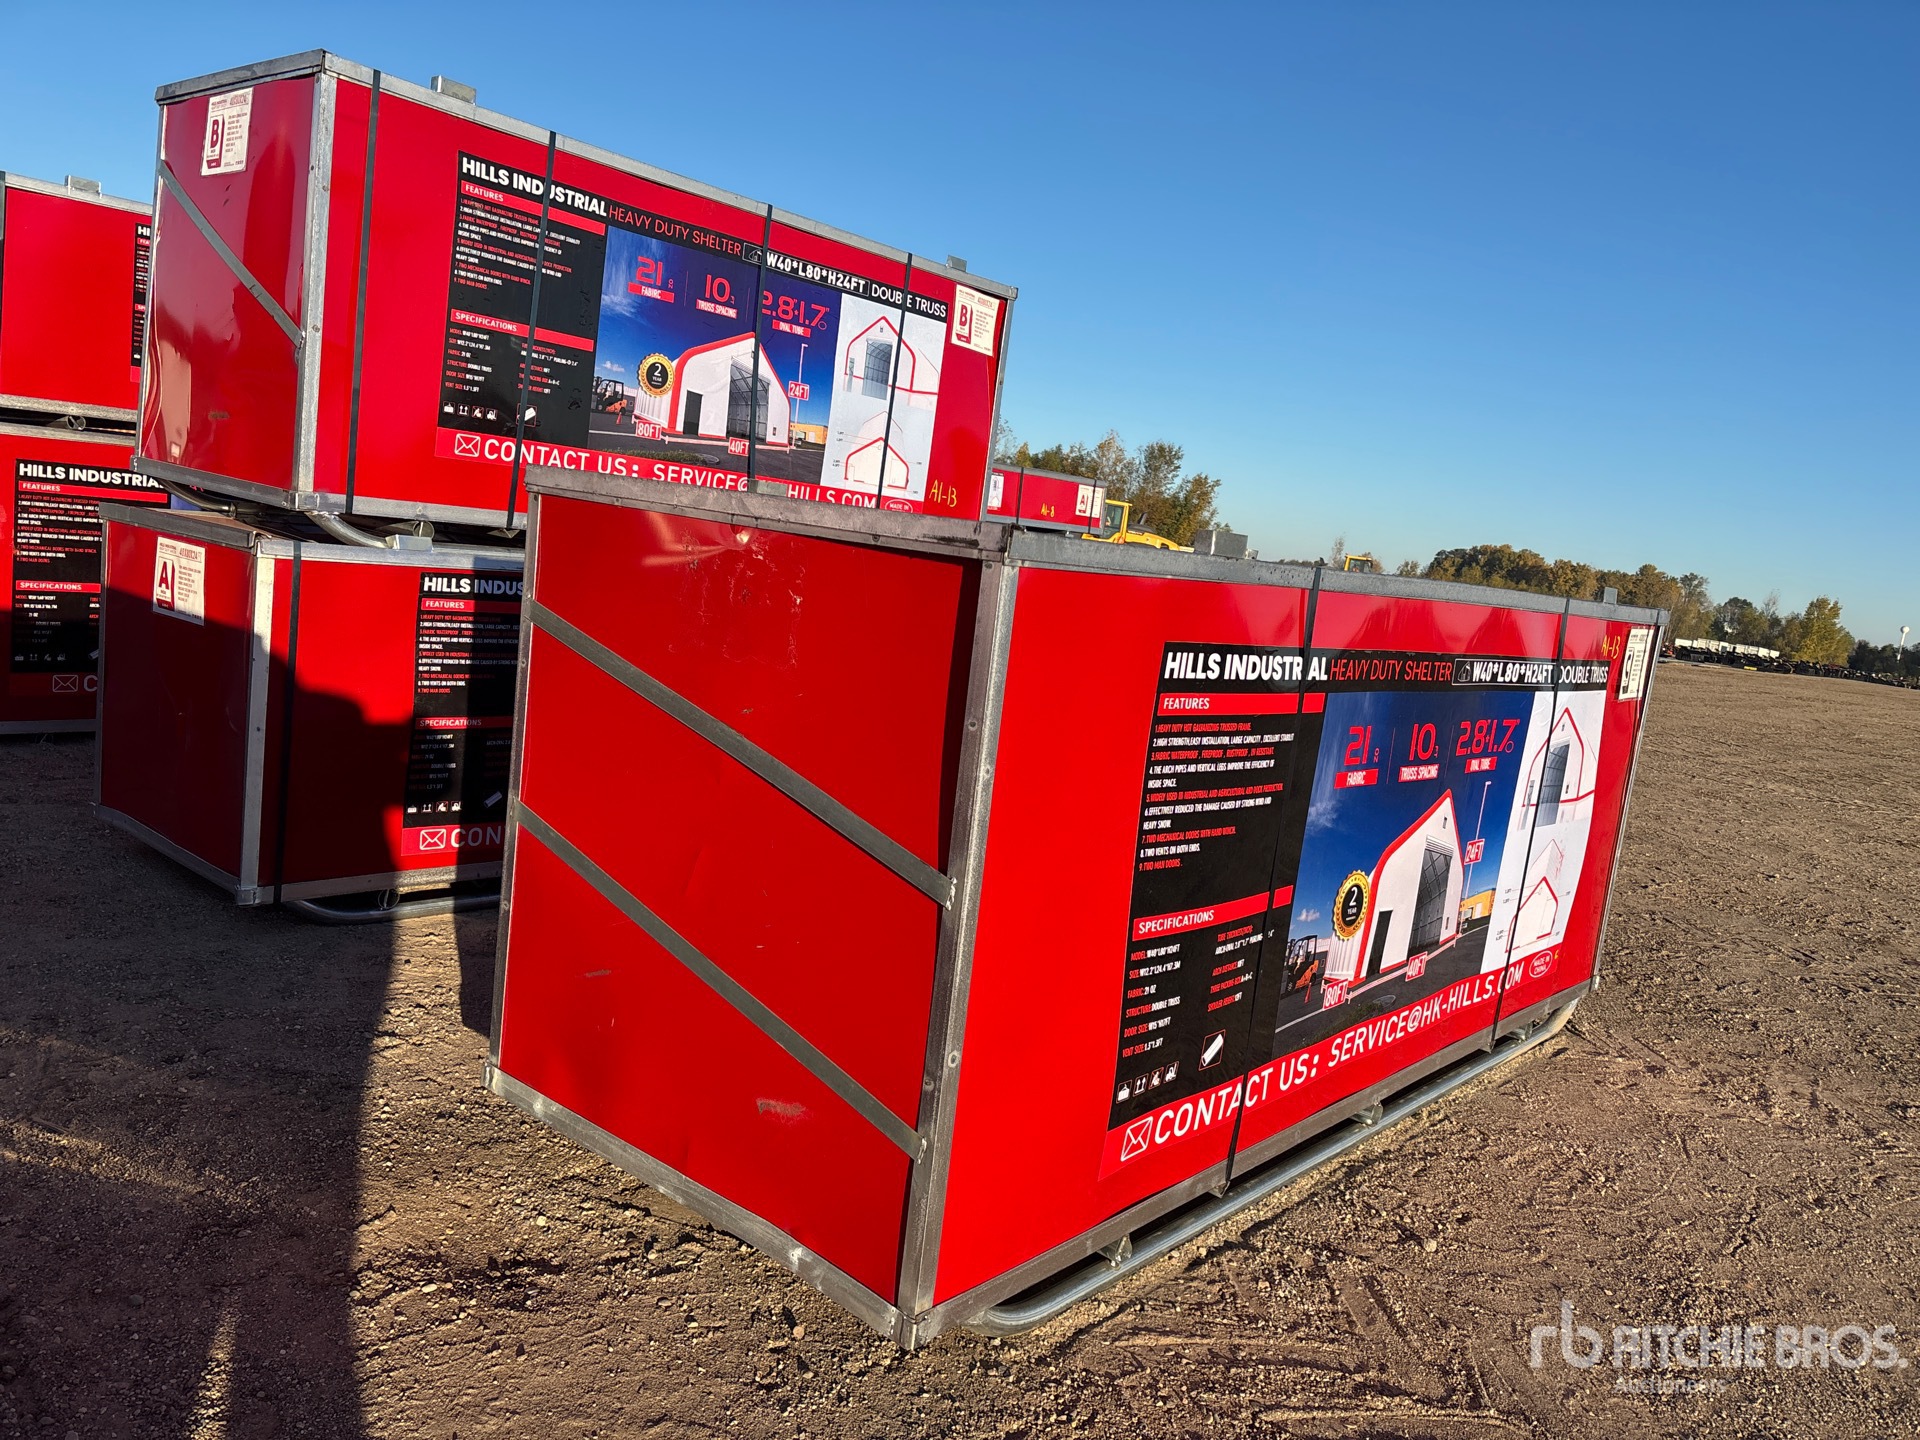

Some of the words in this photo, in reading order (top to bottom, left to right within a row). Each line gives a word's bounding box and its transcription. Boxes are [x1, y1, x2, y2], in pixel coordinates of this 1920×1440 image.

[210, 119, 219, 148] B
[465, 184, 503, 202] FEATURES
[461, 156, 509, 186] HILLS
[609, 204, 651, 230] HEAVY
[654, 218, 688, 241] DUTY
[692, 229, 741, 256] SHELTER
[635, 255, 662, 286] 21
[871, 283, 912, 307] DOUBE
[914, 296, 946, 317] TRUSS
[698, 300, 714, 312] TRUSS
[715, 304, 736, 318] SPACING
[959, 304, 968, 326] B
[455, 312, 516, 331] SPECIFICATIONS
[778, 321, 791, 332] OVAL
[791, 324, 804, 335] TUBE
[653, 363, 662, 376] 2
[789, 382, 808, 399] 24FT
[637, 422, 660, 438] 80FT
[729, 437, 749, 454] 40FT
[483, 438, 589, 471] CONTACT
[19, 463, 66, 480] HILLS
[69, 468, 166, 488] INDUSTRIA
[22, 483, 60, 492] FEATURES
[158, 561, 170, 590] A
[20, 582, 82, 590] SPECIFICATIONS
[424, 576, 470, 593] HILLS
[426, 600, 464, 608] FEATURES
[1164, 652, 1222, 679] HILLS
[1223, 654, 1330, 680] INDUSTRAL
[1329, 658, 1370, 680] HEAVY
[1369, 660, 1402, 680] DUTY
[1403, 660, 1453, 681] SHELTER
[1588, 665, 1608, 682] TRUSS
[1163, 696, 1210, 710] FEATURES
[420, 719, 482, 727] SPECIFICATIONS
[1171, 724, 1182, 732] DUTY
[1230, 735, 1243, 744] LARGE
[1343, 725, 1372, 766] 21
[1162, 765, 1174, 773] ARCH
[1174, 764, 1186, 772] PIPES
[1186, 764, 1196, 772] AND
[1196, 762, 1216, 771] VERTICAL
[1226, 761, 1244, 770] IMPROVE
[1400, 765, 1417, 781] TRUSS
[1417, 763, 1438, 778] SPACING
[1479, 757, 1491, 770] TUBE
[1147, 779, 1162, 788] INSIDE
[1166, 792, 1177, 800] USED
[1208, 788, 1217, 797] AND
[1174, 804, 1194, 813] REDUCED
[1194, 803, 1202, 812] THE
[1202, 801, 1220, 811] DAMAGE
[1220, 800, 1235, 809] CAUSED
[1235, 799, 1241, 807] BY
[1241, 798, 1255, 807] STRONG
[1142, 821, 1157, 830] HEAVY
[1156, 831, 1185, 842] MECHANICAL
[1184, 829, 1200, 839] DOORS
[1155, 846, 1169, 856] VENTS
[1176, 844, 1188, 853] BOTH
[1464, 841, 1483, 862] 24FT
[1153, 860, 1165, 869] MAN
[1348, 885, 1358, 907] 2
[1346, 906, 1357, 916] YEAR
[1138, 909, 1214, 934] SPECIFICATIONS
[1405, 952, 1427, 980] 40FT
[1532, 955, 1545, 969] MADE
[1544, 953, 1550, 964] IN
[1533, 962, 1546, 976] CHINA
[1167, 996, 1181, 1007] TRUSS
[1323, 980, 1348, 1008] 80FT
[1153, 1066, 1273, 1147] CONTACT
[1278, 1046, 1320, 1093] US:
